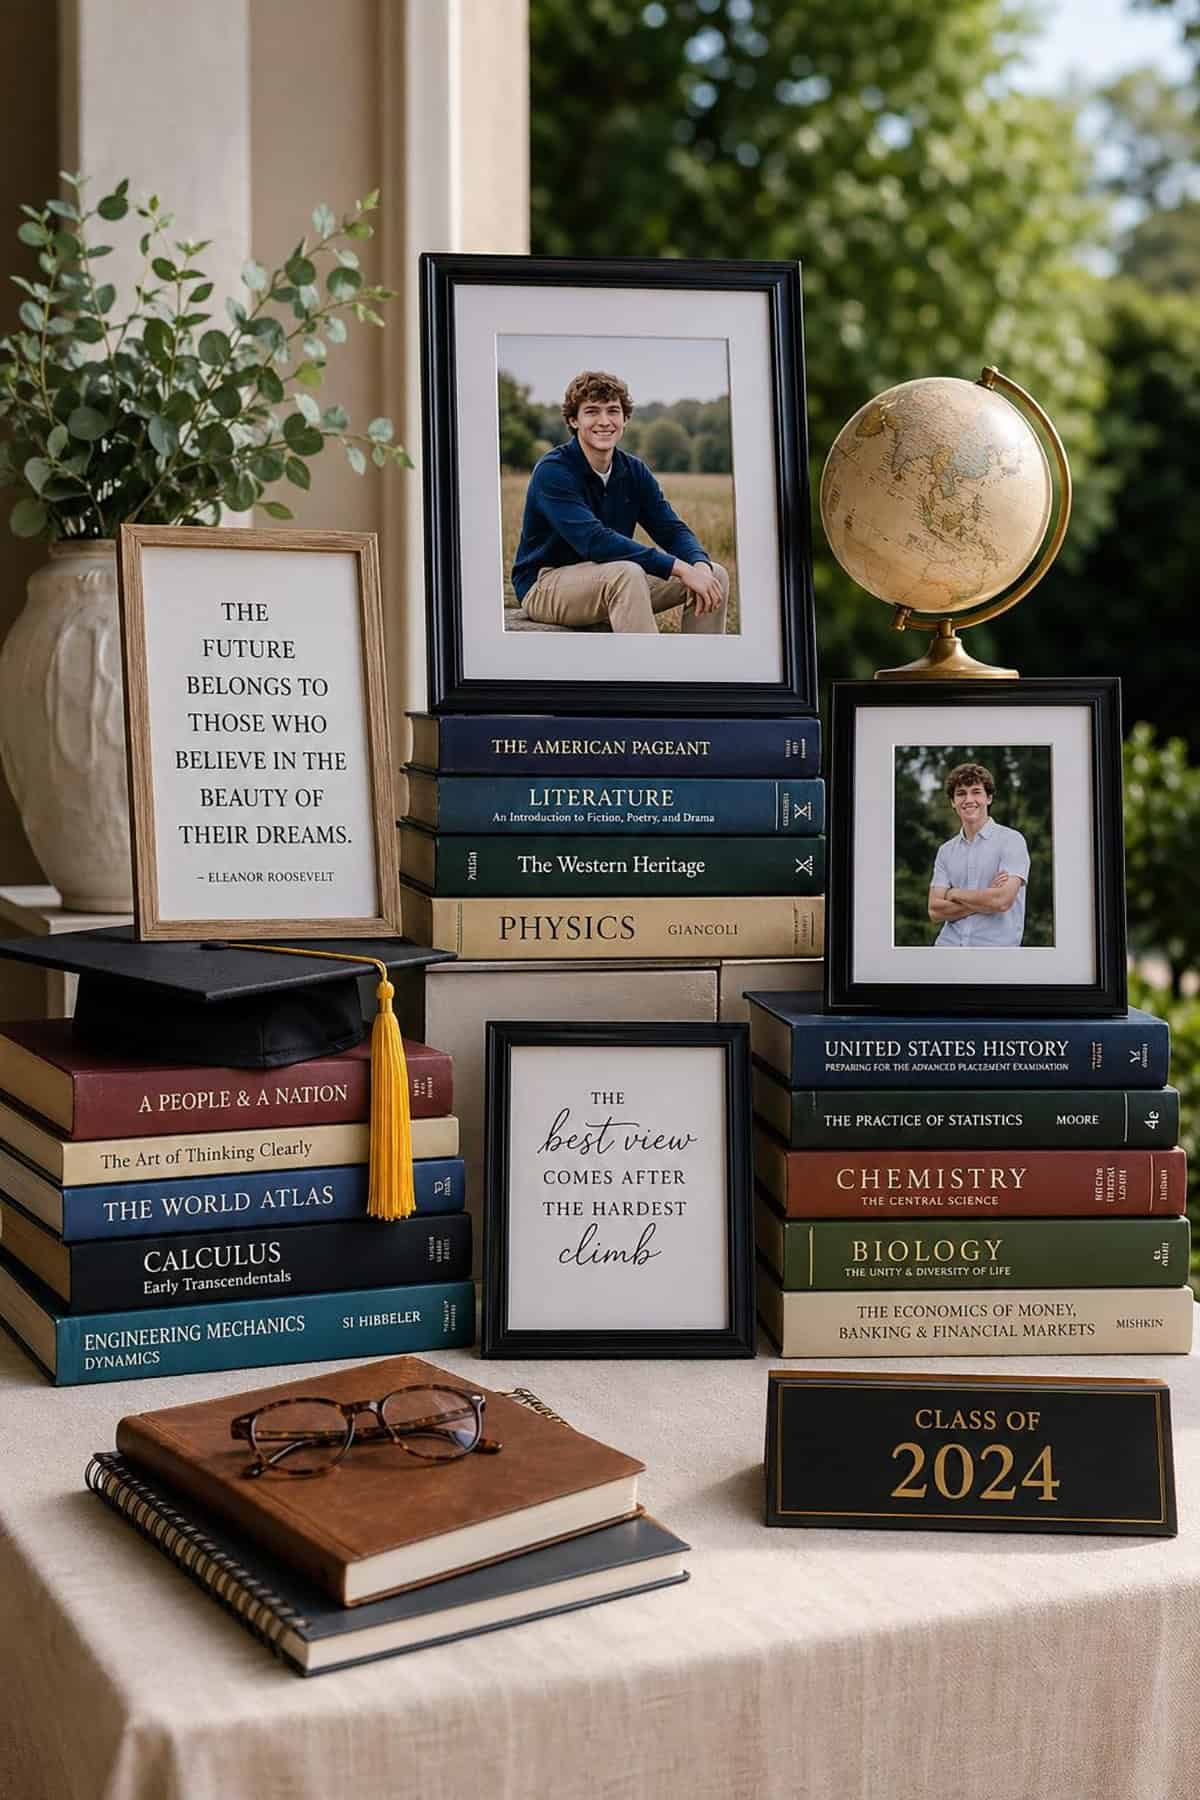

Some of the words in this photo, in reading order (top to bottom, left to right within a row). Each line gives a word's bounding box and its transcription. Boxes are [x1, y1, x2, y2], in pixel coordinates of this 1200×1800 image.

[221, 602, 269, 622] THE
[203, 640, 296, 659] FUTURE
[187, 677, 291, 696] BELONGS
[298, 678, 329, 697] TO
[188, 713, 265, 733] THOSE
[272, 714, 327, 734] WHO
[491, 739, 528, 755] THE
[533, 739, 626, 755] AMERICAN
[632, 740, 711, 757] PAGEANT
[175, 751, 267, 770] BELIEVE
[274, 752, 297, 770] IN
[302, 752, 347, 771] THE
[200, 789, 288, 807] BEAUTY
[295, 789, 324, 808] OF
[529, 789, 674, 807] LITERATURE
[493, 813, 507, 823] An
[510, 812, 571, 823] Introduction
[574, 814, 584, 822] to
[587, 812, 624, 824] Fiction,
[627, 813, 660, 825] Poetry,
[662, 813, 681, 823] and
[683, 813, 715, 823] Drama
[179, 826, 249, 845] THEIR
[256, 826, 353, 846] DREAMS.
[208, 872, 263, 882] ELEANOR
[267, 871, 334, 882] ROOSEVELT
[517, 856, 552, 873] The
[556, 856, 627, 873] Western
[633, 856, 706, 878] Heritage
[499, 915, 635, 941] PHYSICS
[668, 924, 738, 936] GIANCOLI
[825, 1041, 901, 1057] UNITED
[908, 1041, 976, 1057] STATES
[983, 1041, 1070, 1057] HISTORY
[873, 1063, 892, 1072] FOR
[893, 1063, 910, 1072] THE
[139, 1096, 154, 1113] A
[159, 1091, 231, 1112] PEOPLE
[236, 1090, 250, 1107] &
[257, 1089, 271, 1106] A
[276, 1084, 349, 1104] NATION
[591, 1092, 625, 1104] THE
[824, 1115, 852, 1126] THE
[856, 1115, 922, 1126] PRACTICE
[926, 1115, 945, 1126] OF
[949, 1115, 1023, 1126] STATISTICS
[1056, 1115, 1099, 1125] MOORE
[1144, 1110, 1160, 1129] 4e
[537, 1108, 640, 1155] best
[624, 1129, 698, 1151] view
[101, 1153, 132, 1170] The
[135, 1151, 161, 1167] Art
[165, 1149, 181, 1165] of
[184, 1144, 255, 1164] Thinking
[260, 1139, 313, 1160] Clearly
[543, 1170, 613, 1185] COMES
[622, 1170, 686, 1185] AFTER
[836, 1168, 1028, 1189] CHEMISTRY
[104, 1201, 153, 1222] THE
[161, 1193, 250, 1217] WORLD
[261, 1186, 334, 1209] ATLAS
[543, 1201, 583, 1216] THE
[592, 1201, 687, 1216] HARDEST
[861, 1196, 883, 1206] THE
[889, 1196, 944, 1206] CENTRAL
[947, 1196, 999, 1206] SCIENCE
[558, 1223, 661, 1266] climb
[852, 1240, 1003, 1261] BIOLOGY
[143, 1241, 281, 1273] CALCULUS
[845, 1268, 865, 1277] THE
[869, 1267, 902, 1277] UNITY
[916, 1267, 969, 1277] DIVERSITY
[972, 1267, 986, 1276] OF
[989, 1267, 1011, 1276] LIFE
[143, 1280, 179, 1296] Early
[183, 1269, 292, 1292] Transcendentals
[359, 1311, 421, 1328] HIBBELER
[857, 1306, 888, 1318] THE
[893, 1305, 988, 1318] ECONOMICS
[992, 1304, 1013, 1317] OF
[1018, 1303, 1077, 1318] MONEY,
[839, 1325, 911, 1339] BANKING
[916, 1326, 927, 1338] &
[932, 1324, 1018, 1338] FINANCIAL
[1023, 1323, 1096, 1337] MARKETS
[1115, 1319, 1164, 1328] MISHKIN
[84, 1326, 201, 1352] ENGINEERING
[206, 1315, 306, 1340] MECHANICS
[84, 1352, 161, 1370] DYNAMICS
[915, 1409, 997, 1430] CLASS
[1006, 1411, 1041, 1431] OF
[890, 1442, 1061, 1501] 2024
